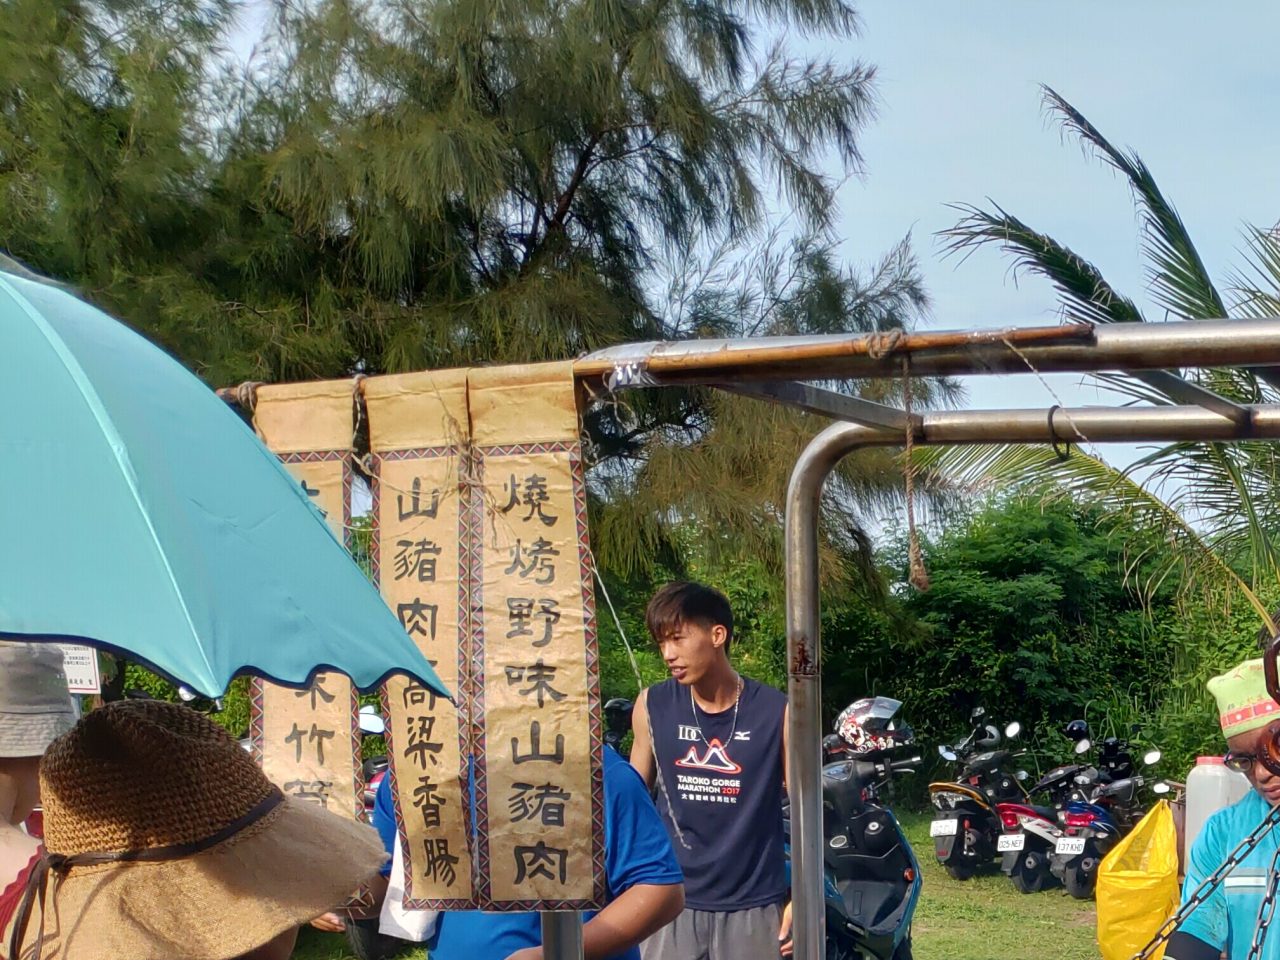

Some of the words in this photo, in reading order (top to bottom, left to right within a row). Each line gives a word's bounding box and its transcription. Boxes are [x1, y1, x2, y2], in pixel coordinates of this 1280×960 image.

[502, 473, 571, 885] 燒烤野味山豬肉
[676, 774, 710, 786] TAROKO
[711, 778, 741, 788] GORGE
[677, 783, 721, 793] MARATHON
[721, 787, 740, 795] 2017
